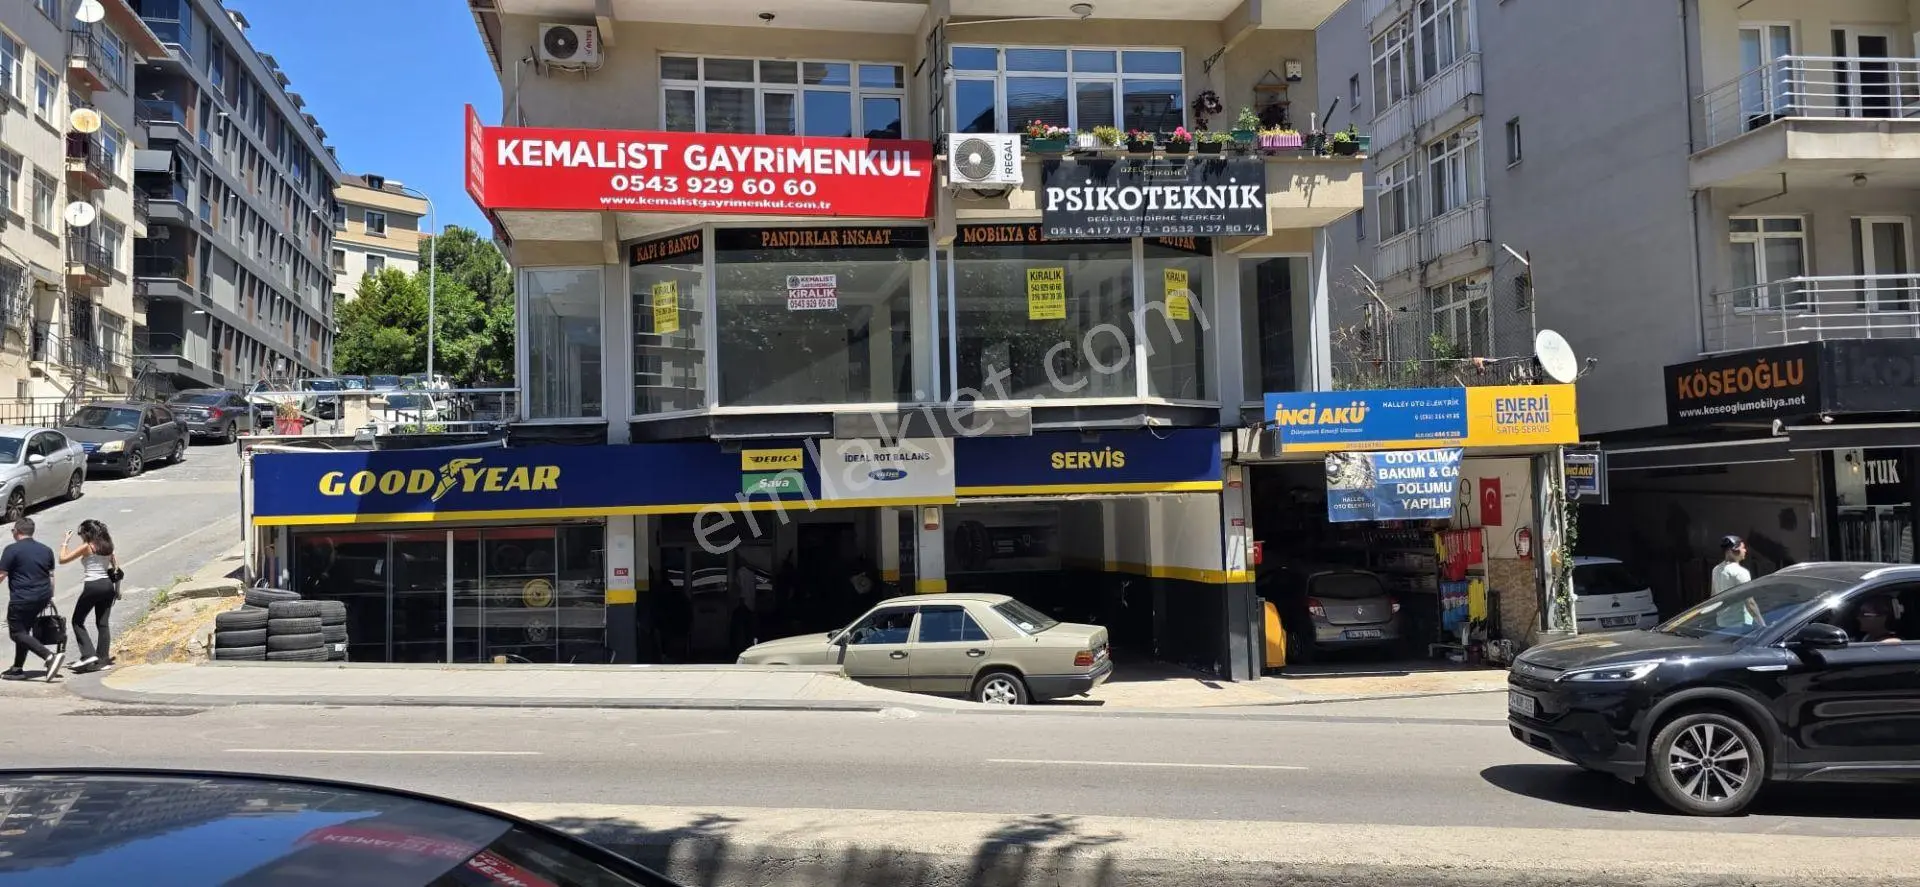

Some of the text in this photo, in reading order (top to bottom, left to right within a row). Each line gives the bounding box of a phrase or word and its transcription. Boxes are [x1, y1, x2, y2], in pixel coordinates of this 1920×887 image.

[611, 175, 816, 196] 0543 929 60 60
[1046, 178, 1263, 211] PSİKOTEKNİK
[600, 196, 831, 210] www.kemalistgayrimenkul.com.tr
[1028, 226, 1037, 240] &
[1162, 225, 1194, 233] 0532
[660, 243, 666, 256] &
[668, 234, 699, 254] BANYO
[762, 230, 839, 246] PANDIRLAR
[1677, 358, 1804, 400] KÖSEOĞLU
[1496, 394, 1548, 412] ENERJİ
[1679, 394, 1806, 418] www.koseoglumobilya.net
[1276, 402, 1316, 426] İNCİ
[1496, 412, 1549, 424] UZMANI
[845, 452, 871, 462] İDEAL
[874, 453, 890, 461] ROT
[1052, 446, 1126, 469] SERVİS
[1386, 452, 1414, 464] OTO
[1379, 466, 1460, 480] BAKIMI & GA
[759, 478, 789, 488] Sava
[1397, 482, 1452, 494] DOLUMU
[1401, 498, 1451, 509] YAPILIR
